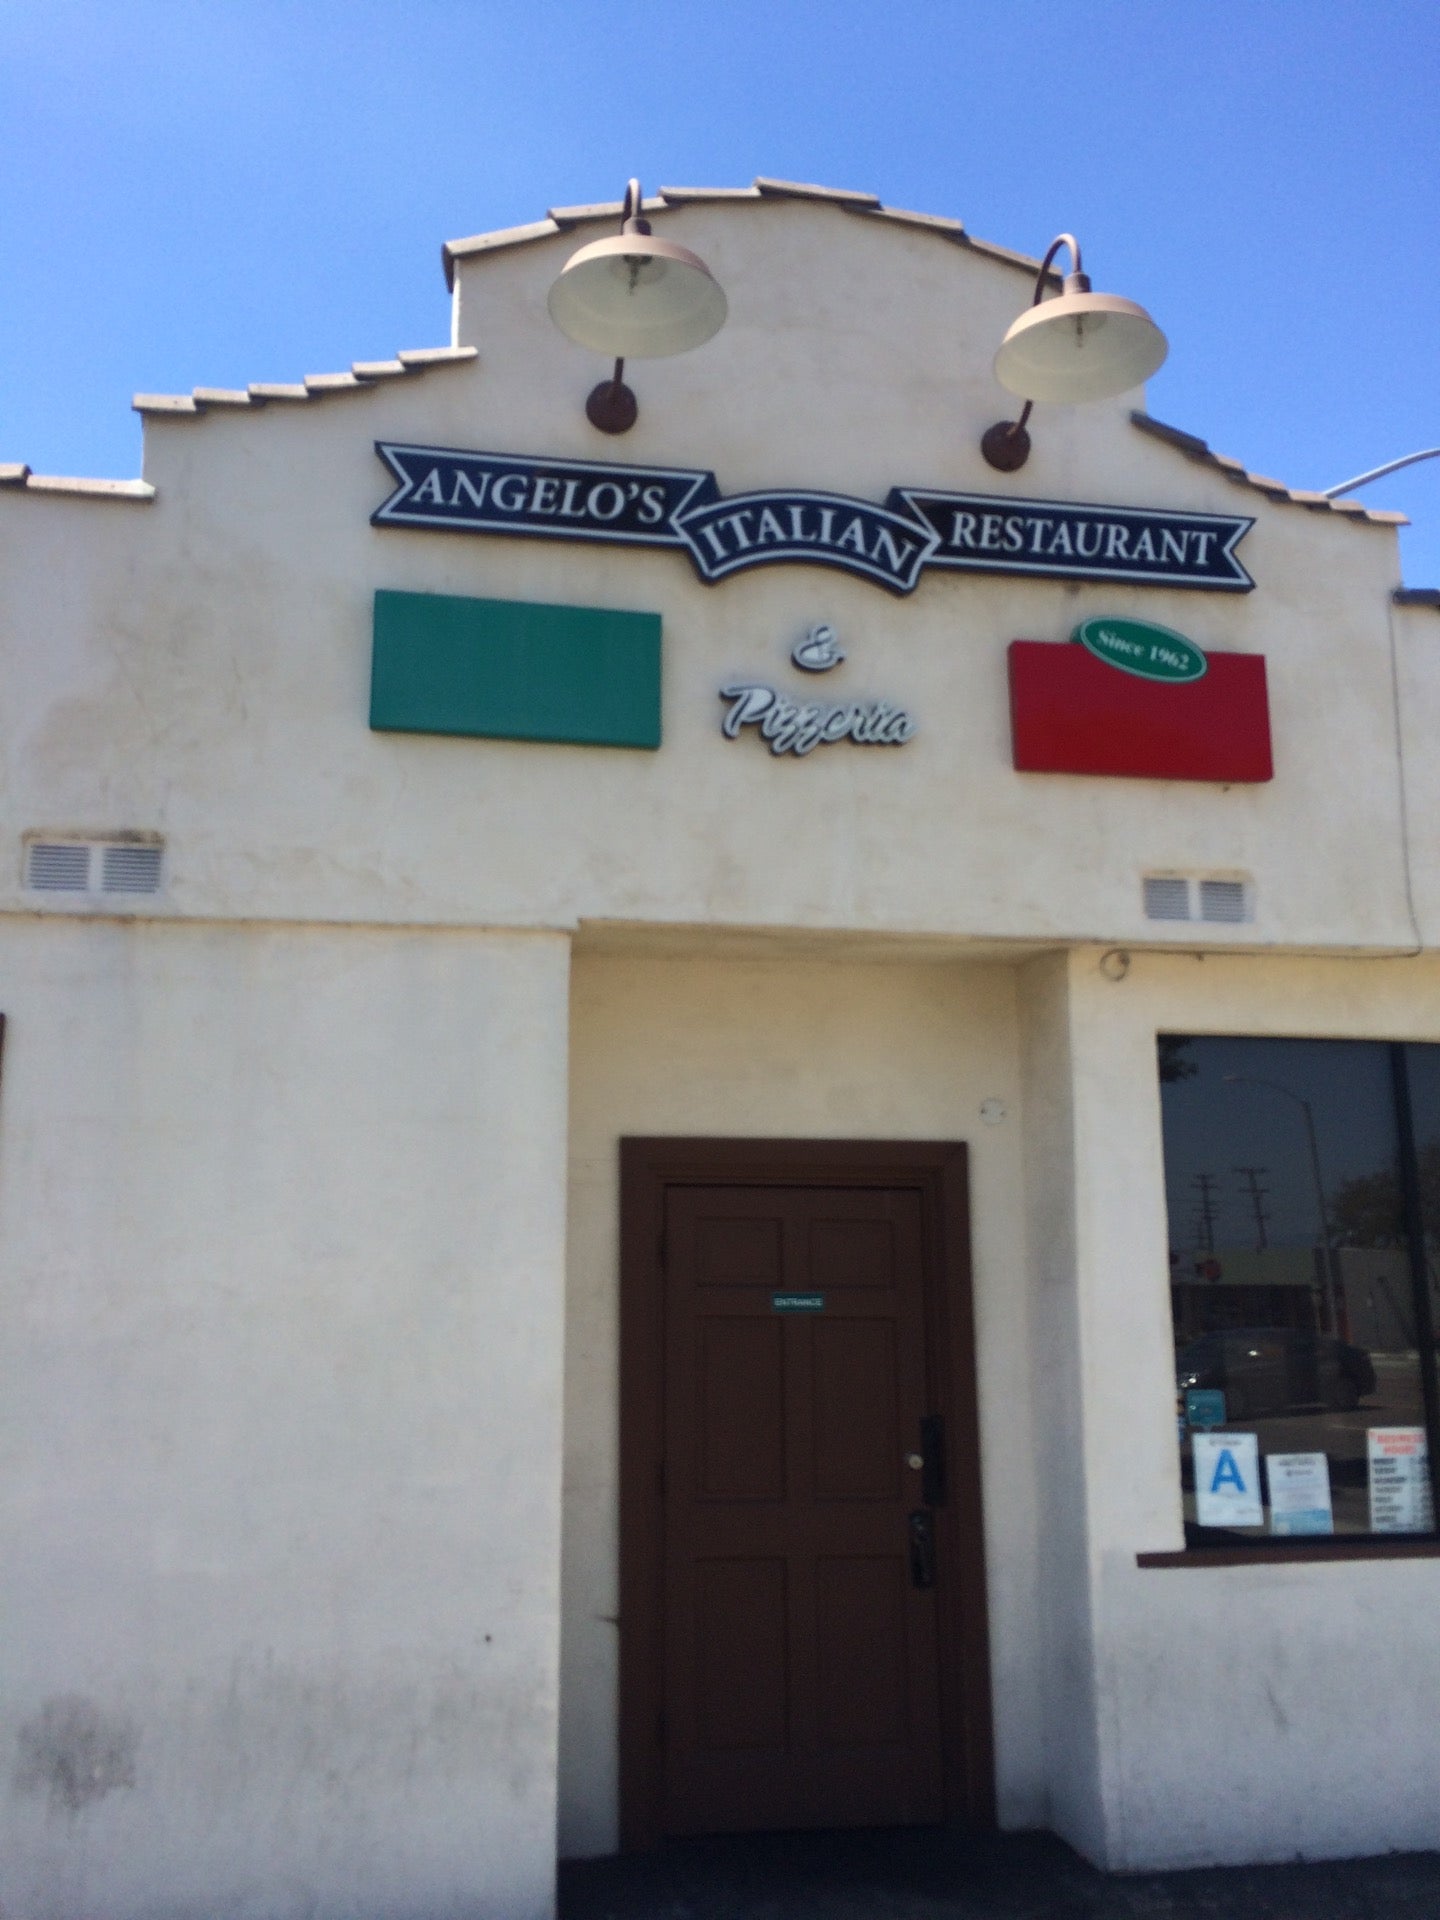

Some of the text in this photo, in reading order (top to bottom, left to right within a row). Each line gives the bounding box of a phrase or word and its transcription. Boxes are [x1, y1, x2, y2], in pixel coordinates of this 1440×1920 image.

[412, 468, 1217, 573] ANGELO'S ITALIAN RESTAURANT
[791, 624, 845, 671] &
[1097, 628, 1190, 671] Since 1962
[719, 684, 917, 756] Pizzeria
[1210, 1448, 1248, 1494] A
